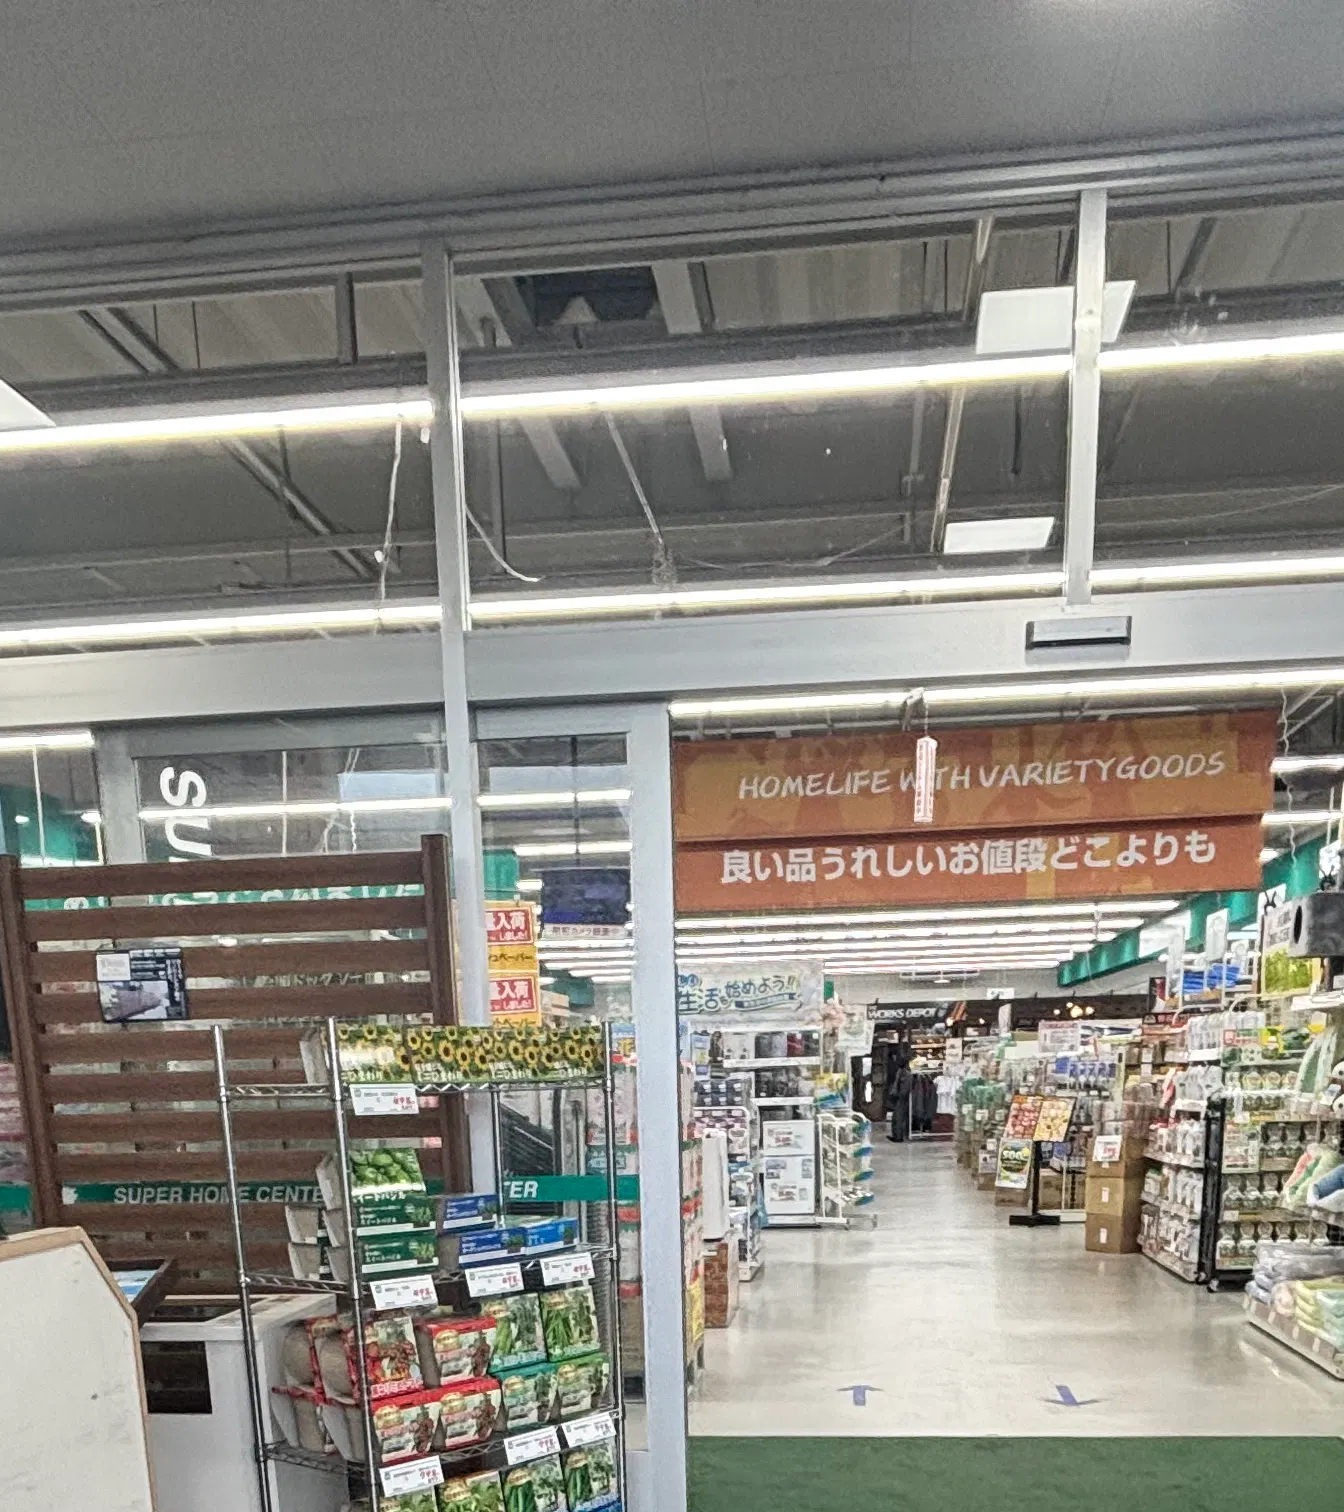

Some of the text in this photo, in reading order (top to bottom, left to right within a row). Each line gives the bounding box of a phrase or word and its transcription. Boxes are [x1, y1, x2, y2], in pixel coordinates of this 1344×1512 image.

[738, 769, 891, 801] HOMELIFE
[899, 764, 971, 792] WTH
[159, 766, 214, 862] SU
[720, 828, 1218, 886] 良い品うれしいお値段どこよりも
[113, 1186, 184, 1204] SUPER
[189, 1184, 250, 1203] HOME
